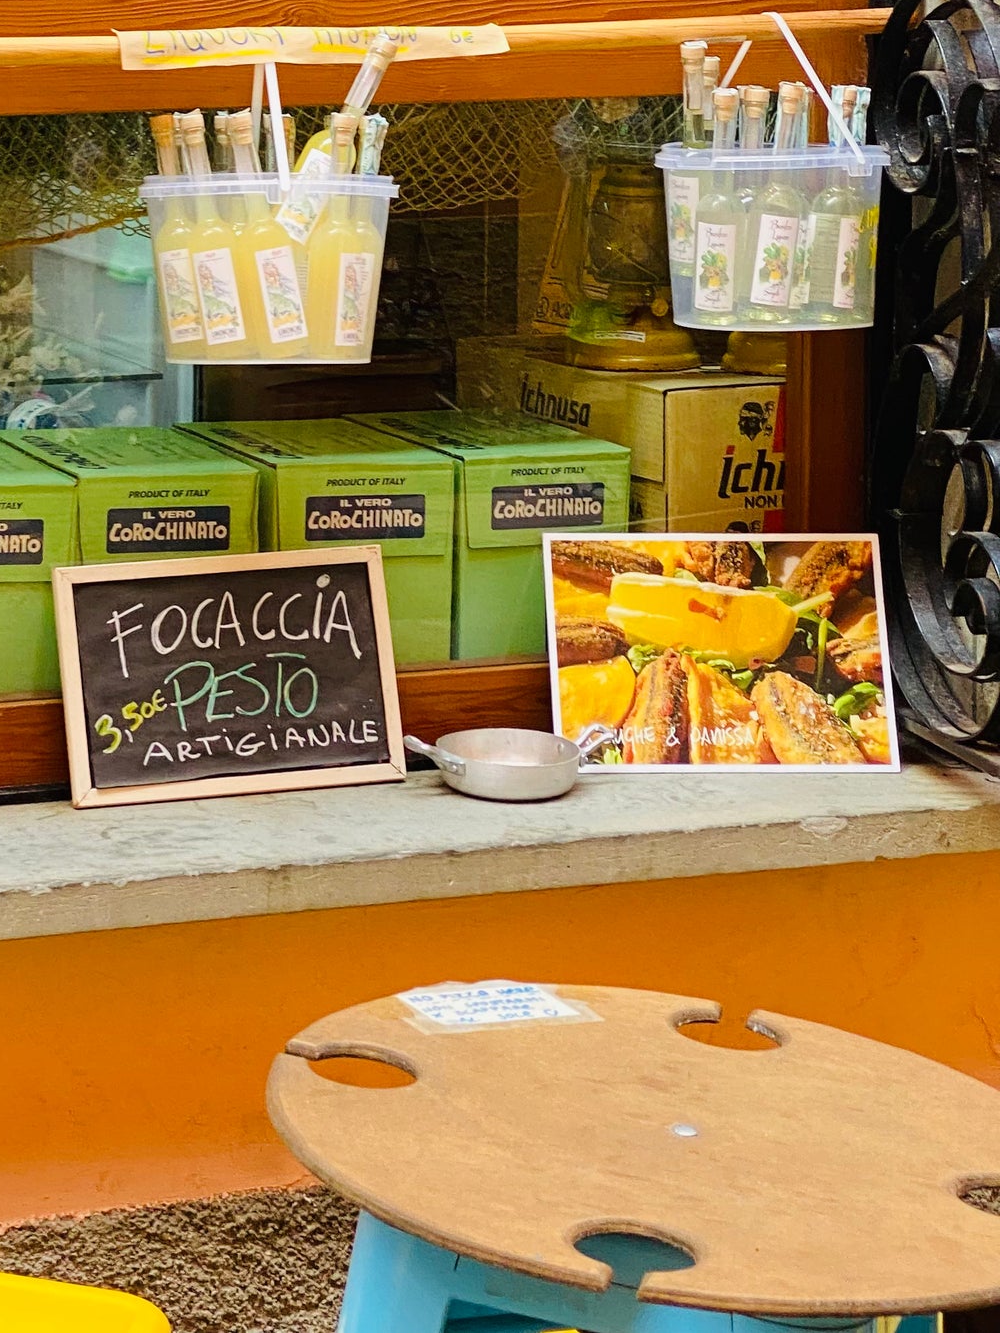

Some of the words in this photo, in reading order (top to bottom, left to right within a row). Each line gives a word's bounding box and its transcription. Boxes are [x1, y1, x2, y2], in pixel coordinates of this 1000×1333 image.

[510, 467, 549, 477] PRODUCT
[551, 466, 562, 474] OF
[326, 478, 367, 487] PRODUCT
[368, 477, 381, 486] OF
[382, 477, 406, 486] ITALY
[128, 490, 170, 499] PRODUCT
[172, 489, 184, 497] OF
[185, 489, 211, 497] ITALY
[523, 488, 536, 497] IL
[538, 486, 573, 496] VERO
[340, 498, 352, 507] IL
[355, 498, 392, 507] VERO
[744, 494, 778, 509] NON
[142, 511, 156, 519] IL
[158, 509, 196, 519] VERO
[106, 573, 362, 679] FOCACCIA
[164, 651, 319, 732] PESTO
[665, 725, 681, 747] &
[142, 719, 380, 767] ARTIGIANALE
